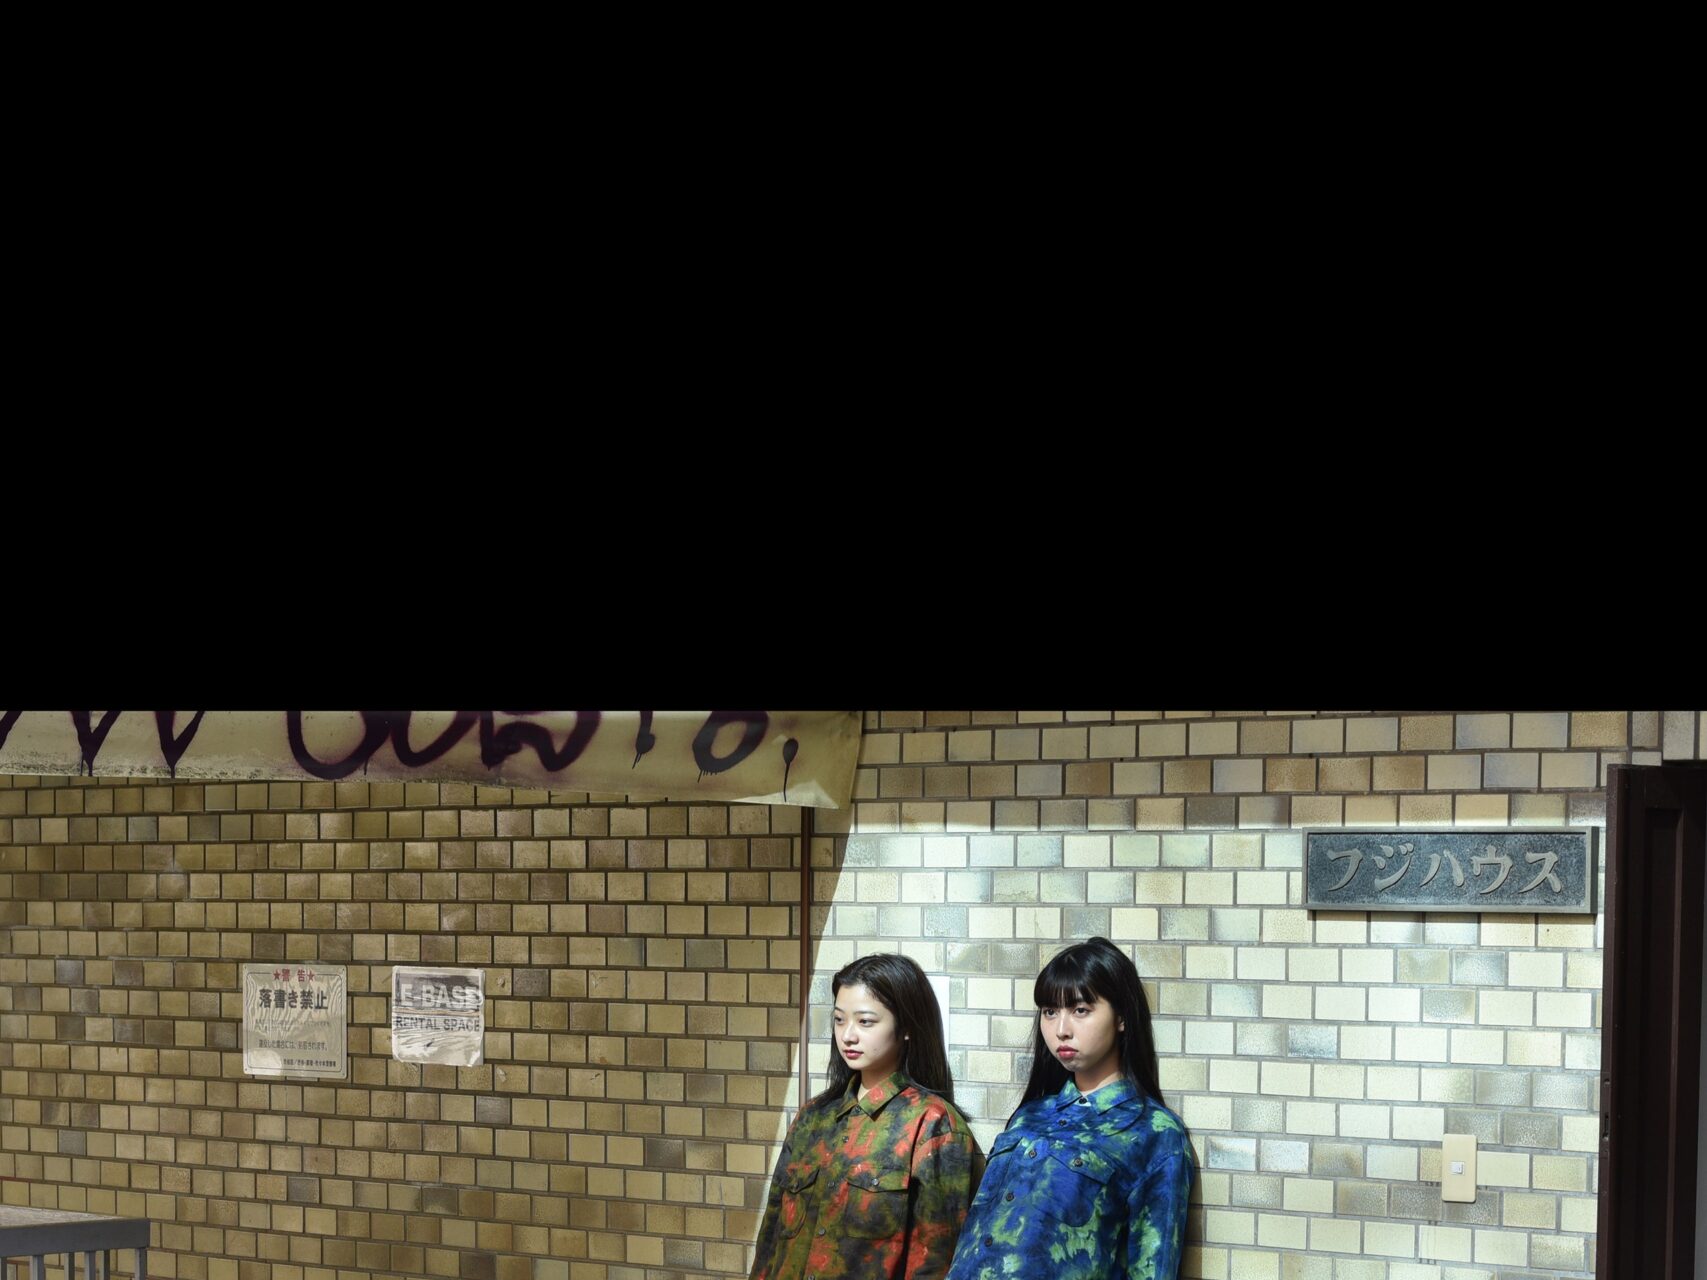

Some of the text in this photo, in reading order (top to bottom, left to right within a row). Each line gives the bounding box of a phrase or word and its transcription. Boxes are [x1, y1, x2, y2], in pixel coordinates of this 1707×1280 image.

[1326, 842, 1563, 895] フジハウス
[258, 988, 328, 1010] 落書き禁止
[395, 1016, 480, 1032] RENTAL SPACE
